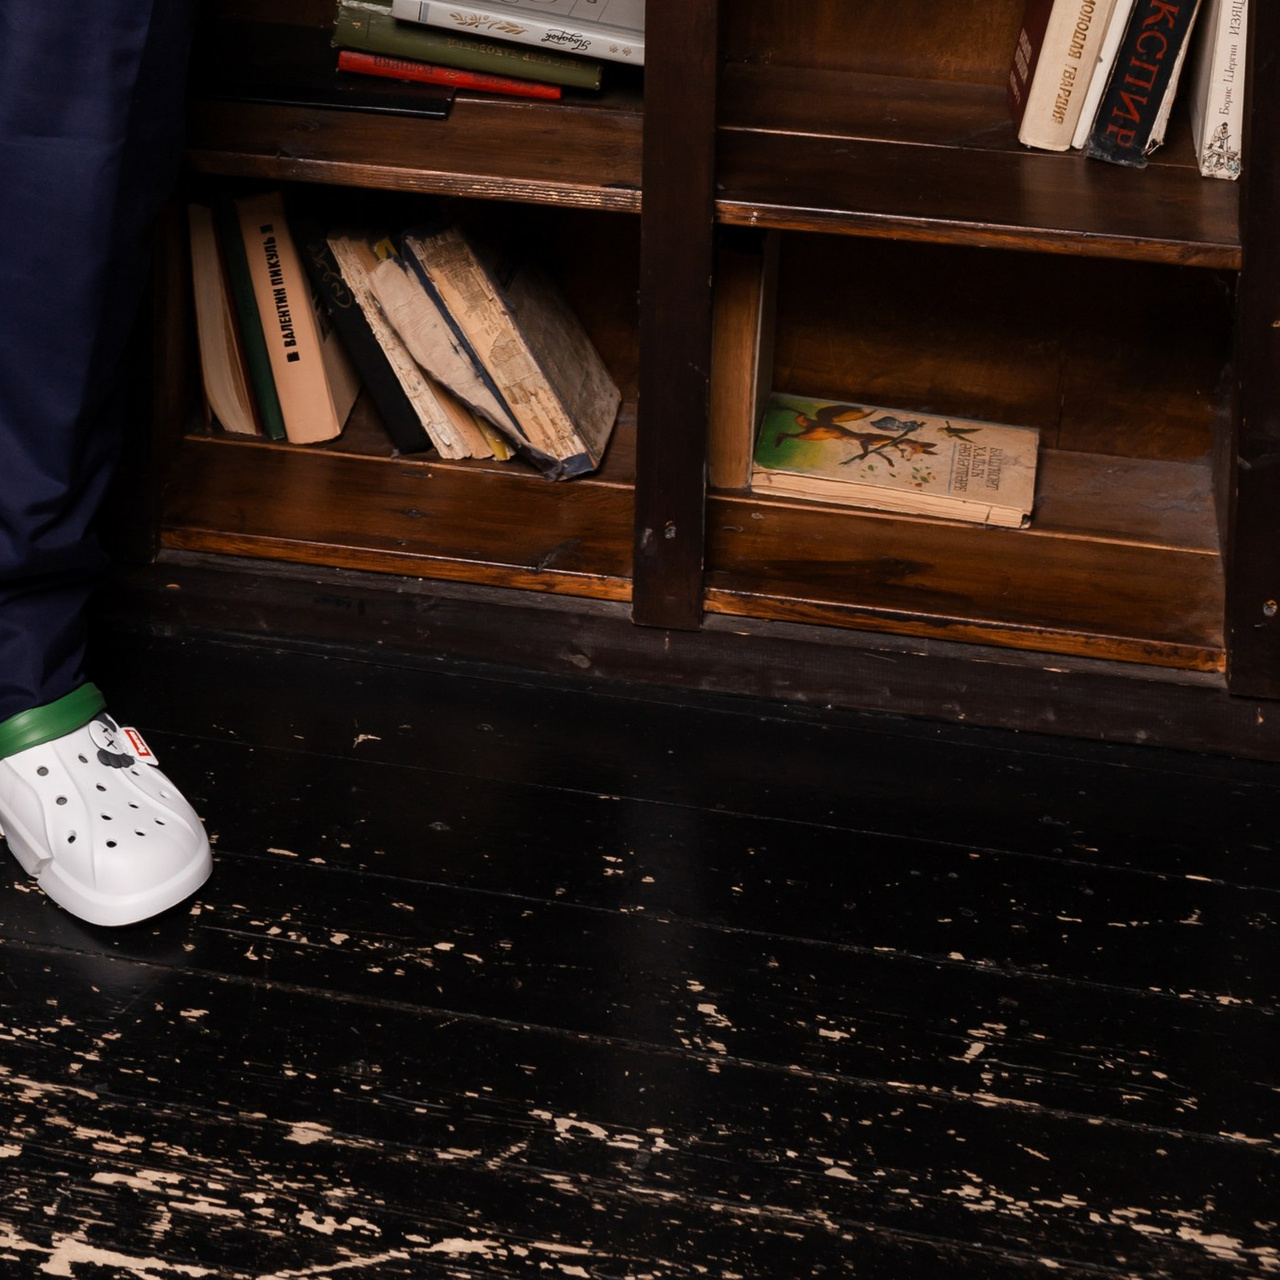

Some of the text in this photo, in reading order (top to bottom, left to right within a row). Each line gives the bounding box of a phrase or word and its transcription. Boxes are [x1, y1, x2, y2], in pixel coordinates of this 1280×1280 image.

[538, 26, 592, 54] Подарок
[1049, 61, 1077, 124] ГВАРДИЯ
[1217, 43, 1239, 116] Борис Шергин
[261, 235, 297, 349] ВАЛЕНТИН ПИКУЛЬ
